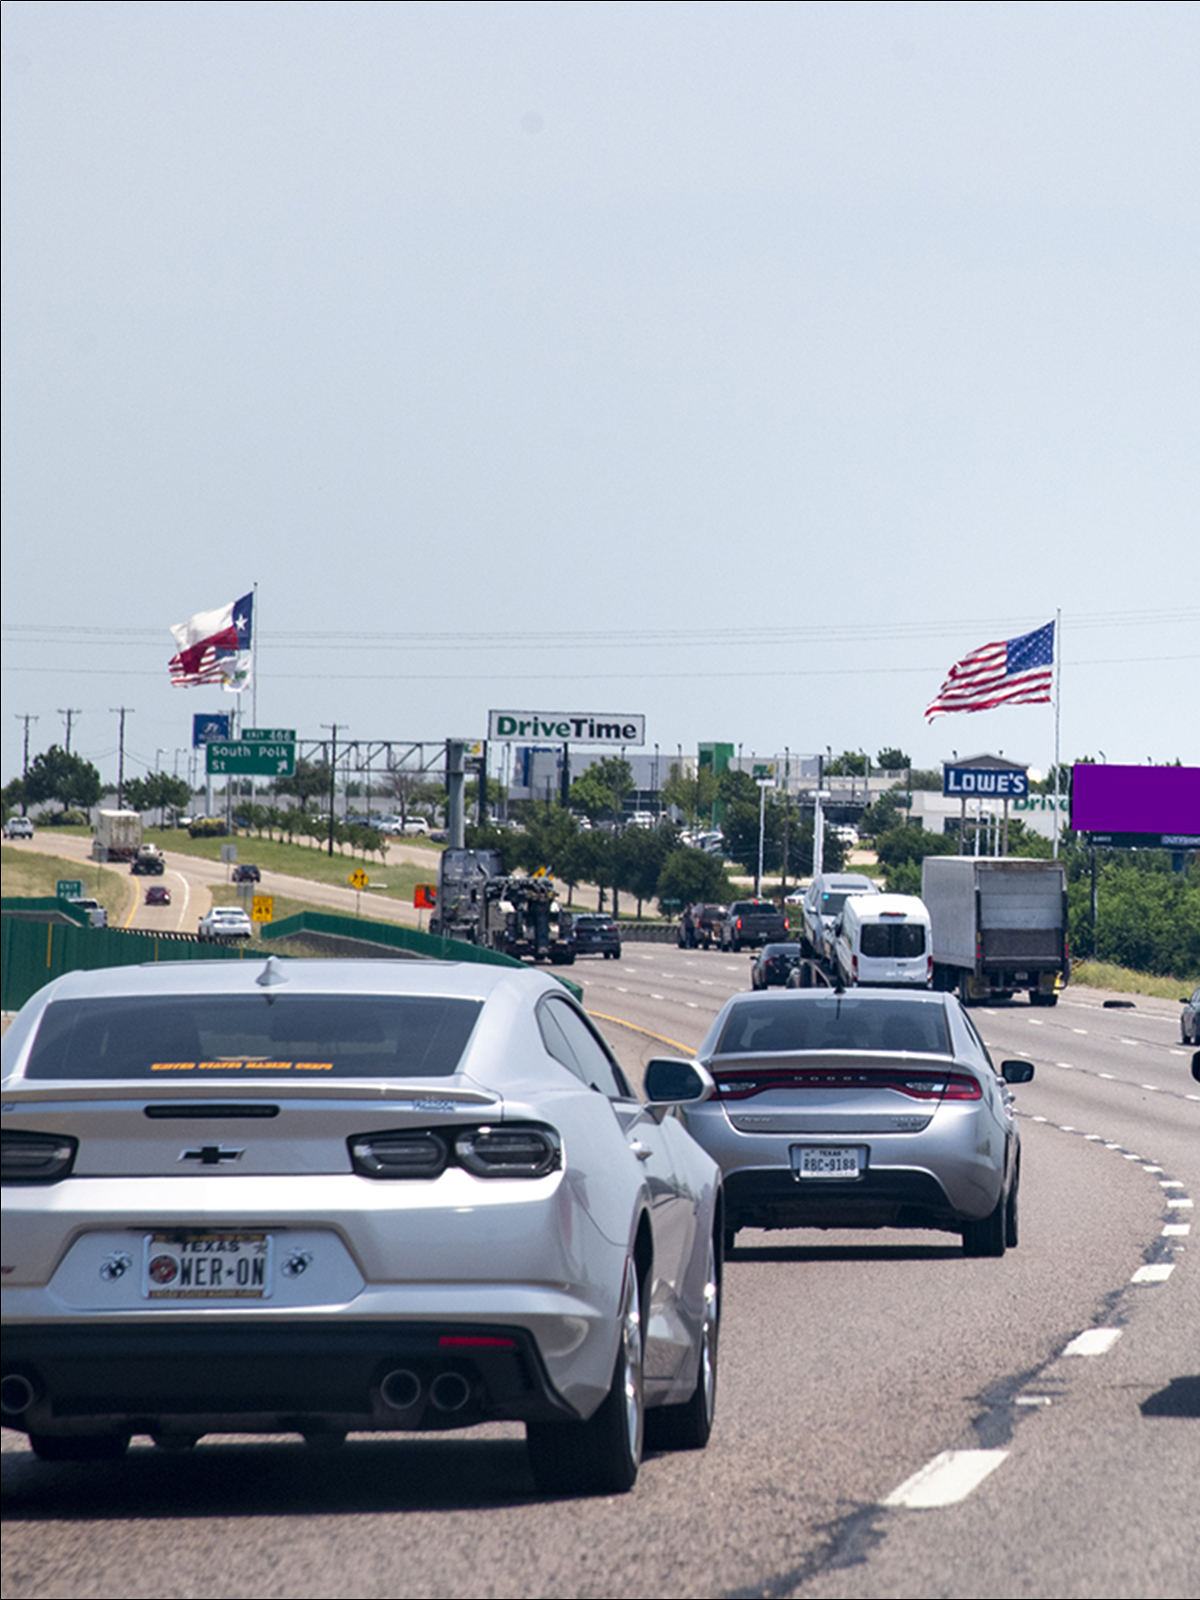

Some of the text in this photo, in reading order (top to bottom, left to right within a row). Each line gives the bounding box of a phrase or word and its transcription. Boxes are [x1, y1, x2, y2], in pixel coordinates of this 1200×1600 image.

[497, 716, 637, 738] DriveTime
[246, 731, 264, 739] EXIT
[212, 745, 288, 758] South Polk
[212, 760, 225, 771] St
[948, 770, 1025, 793] LOWE'S
[181, 1241, 240, 1253] TEXAS
